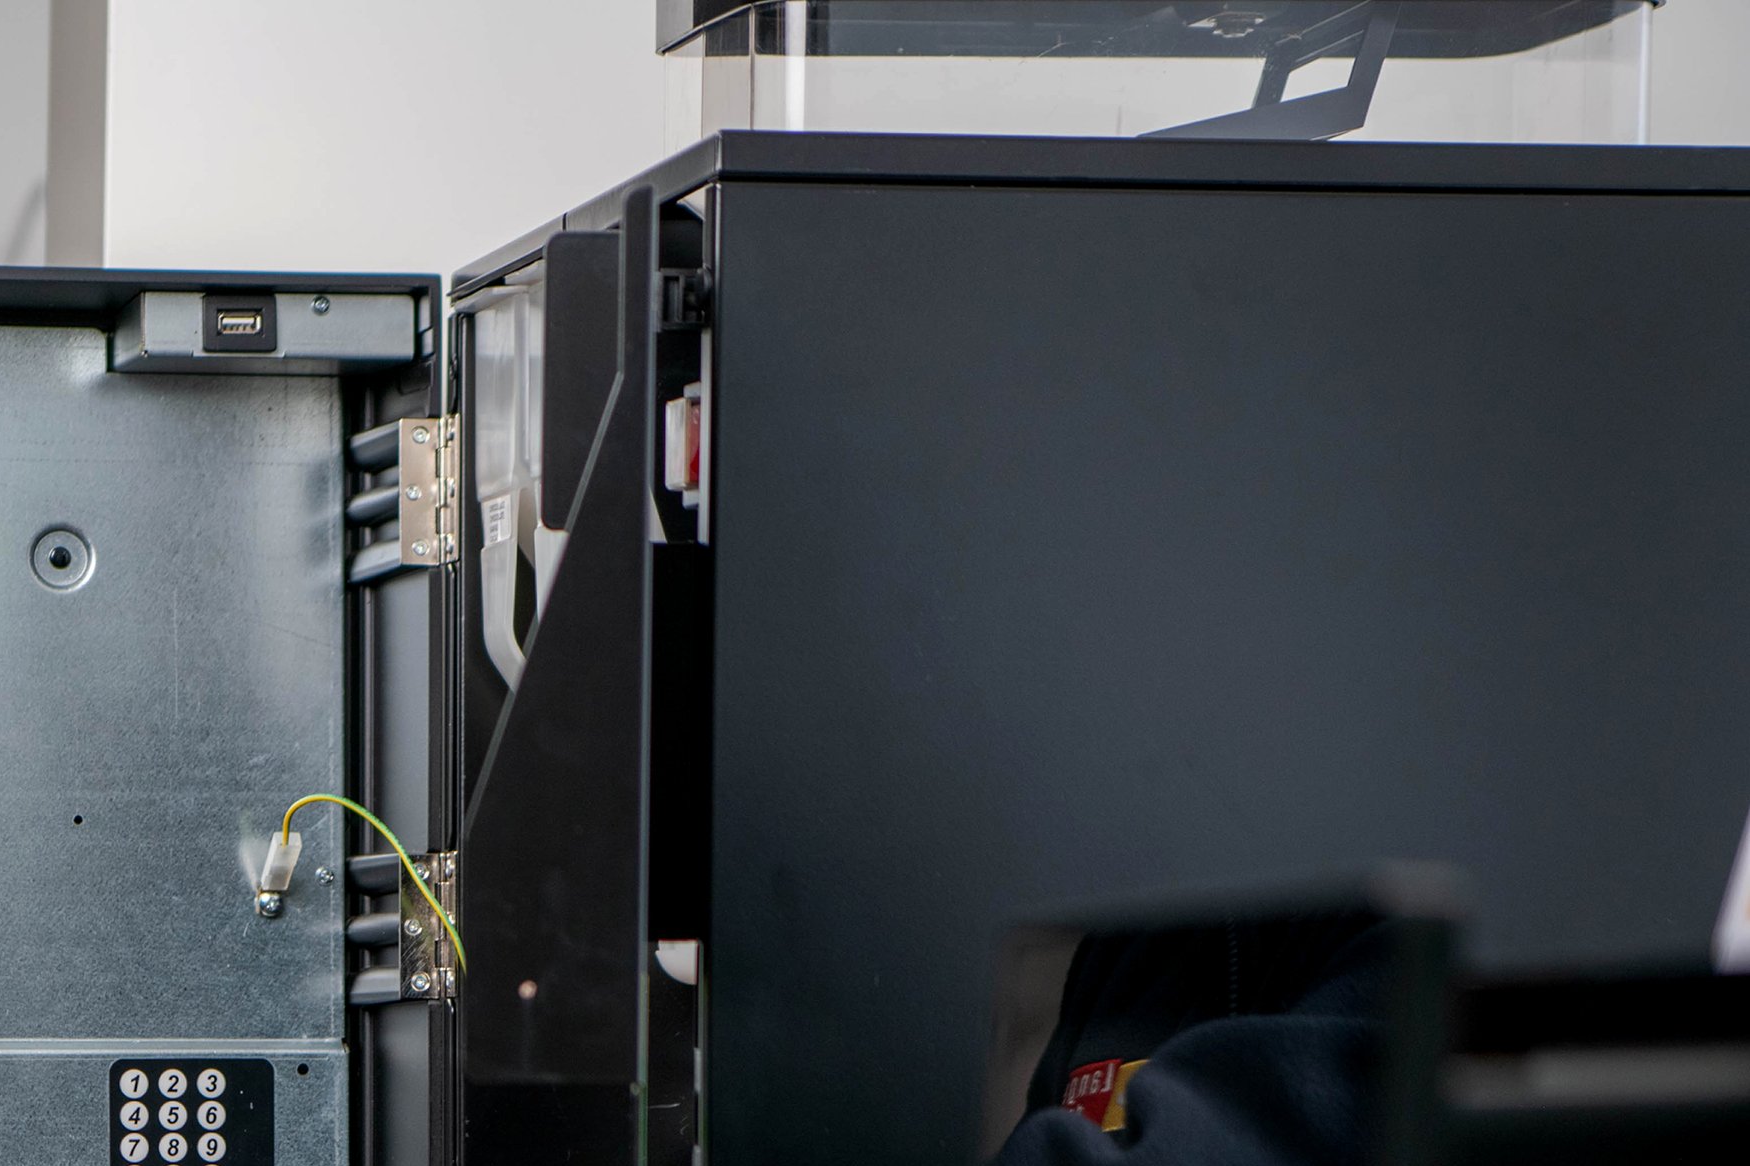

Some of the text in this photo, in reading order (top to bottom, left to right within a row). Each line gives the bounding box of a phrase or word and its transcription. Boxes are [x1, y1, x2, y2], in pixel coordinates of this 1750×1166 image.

[130, 1075, 217, 1092] 1 2 3
[128, 1107, 217, 1124] 4 5 6
[128, 1138, 218, 1157] 7 8 9
